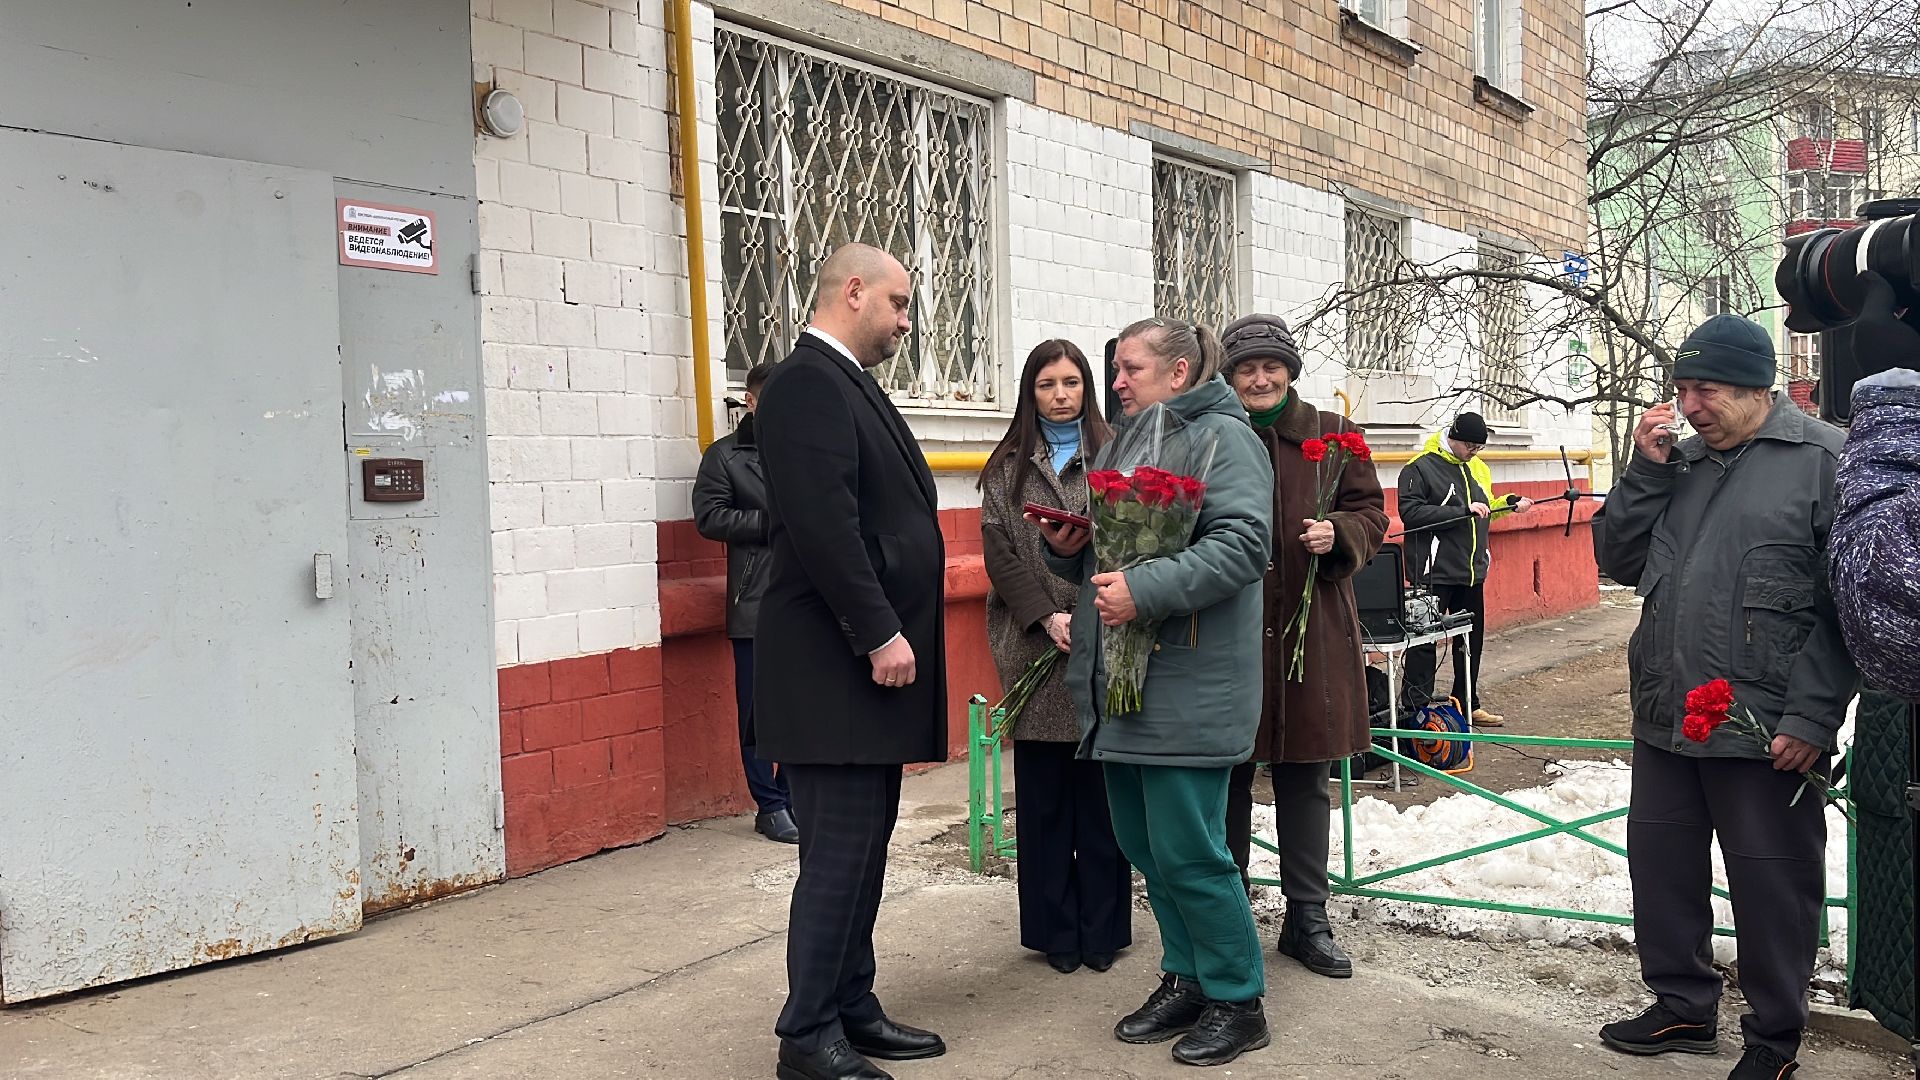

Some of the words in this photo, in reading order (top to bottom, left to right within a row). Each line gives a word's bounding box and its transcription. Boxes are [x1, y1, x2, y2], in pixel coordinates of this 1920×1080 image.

[347, 223, 388, 235] ВНИМАНИЕ
[348, 235, 384, 246] ВЕДЕТСЯ
[348, 244, 430, 260] ВИДЕОНАБЛЮДЕНИЕ!
